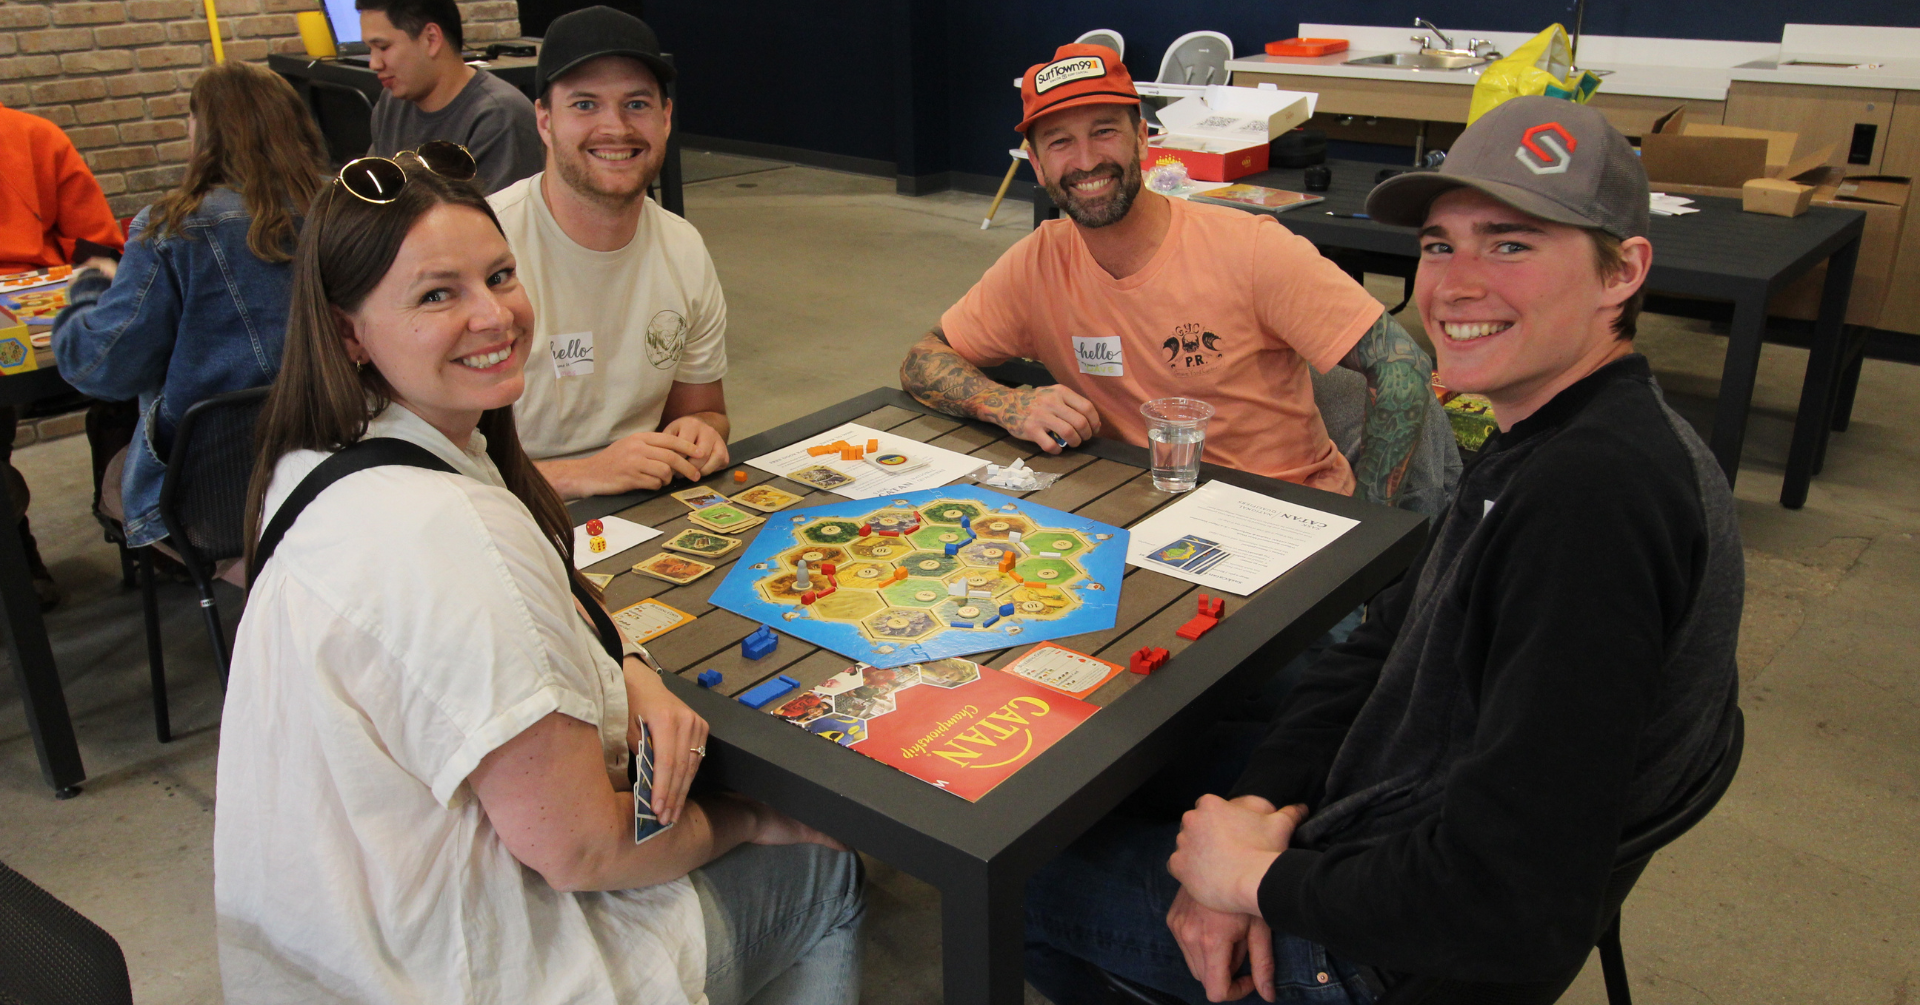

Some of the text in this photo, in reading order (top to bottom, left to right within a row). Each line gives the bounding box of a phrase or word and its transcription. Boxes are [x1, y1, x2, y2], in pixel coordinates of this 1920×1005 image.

[1074, 342, 1122, 360] hello
[1185, 354, 1208, 368] P.R.
[1280, 512, 1328, 528] CATAN
[900, 704, 979, 759] Championship
[931, 696, 1050, 768] CATAN
